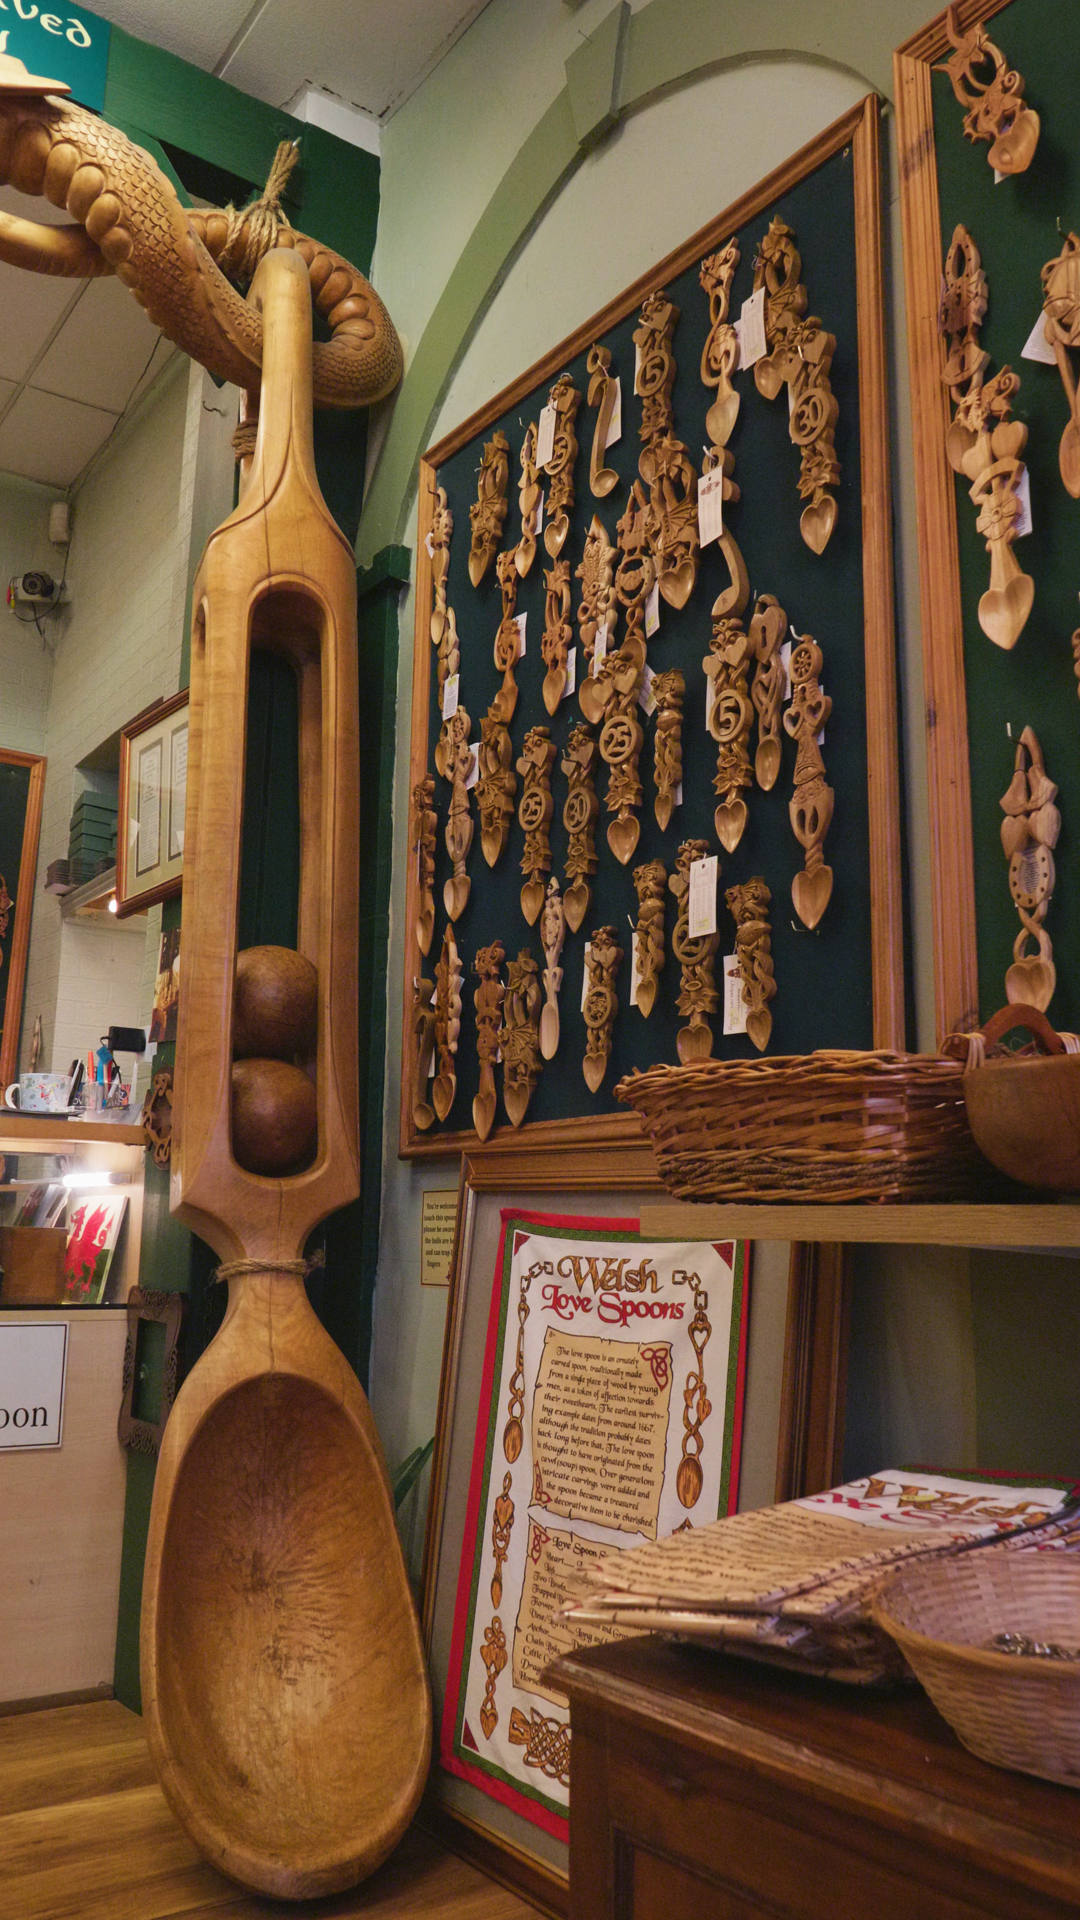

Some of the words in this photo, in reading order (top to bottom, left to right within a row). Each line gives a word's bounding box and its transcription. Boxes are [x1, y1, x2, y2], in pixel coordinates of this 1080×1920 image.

[0, 0, 92, 48] ved
[427, 1260, 440, 1268] fingers
[557, 1255, 664, 1294] Welsh
[541, 1284, 594, 1320] Love
[597, 1292, 686, 1328] Spoons
[551, 1359, 570, 1368] carved
[590, 1365, 624, 1380] traditionally
[625, 1370, 642, 1379] made
[557, 1346, 569, 1356] The
[571, 1348, 582, 1358] love
[584, 1350, 600, 1362] spoon
[616, 1356, 639, 1368] ornately
[546, 1382, 562, 1392] men,
[577, 1387, 592, 1396] token
[601, 1390, 626, 1403] affection
[627, 1395, 654, 1406] towards
[547, 1369, 563, 1380] from
[570, 1374, 585, 1385] single
[587, 1376, 600, 1387] piece
[610, 1381, 627, 1390] wood
[629, 1382, 636, 1394] by
[638, 1385, 658, 1396] young
[542, 1405, 553, 1415] ing
[555, 1409, 580, 1421] example
[582, 1413, 596, 1423] dates
[596, 1416, 612, 1426] from
[614, 1420, 636, 1431] around
[544, 1392, 560, 1402] their
[598, 1403, 613, 1414] The
[615, 1406, 637, 1417] earliest
[638, 1410, 664, 1419] surviv-
[537, 1428, 552, 1439] back
[554, 1432, 569, 1445] long
[571, 1436, 589, 1447] before
[606, 1443, 620, 1454] The
[622, 1446, 635, 1456] love
[637, 1449, 654, 1460] spoon
[539, 1417, 568, 1431] although
[570, 1422, 579, 1432] the
[581, 1424, 606, 1438] tradition
[608, 1432, 633, 1445] probably
[635, 1435, 651, 1445] dates
[542, 1441, 568, 1456] thought
[578, 1449, 592, 1460] have
[594, 1455, 625, 1467] originated
[625, 1459, 640, 1471] from
[642, 1462, 653, 1472] the
[542, 1467, 570, 1480] intricate
[572, 1476, 598, 1490] carvings
[600, 1482, 616, 1492] were
[618, 1485, 636, 1496] added
[637, 1490, 650, 1499] and
[600, 1468, 617, 1478] Over
[618, 1473, 655, 1486] generations
[546, 1481, 555, 1491] the
[558, 1486, 577, 1495] spoon
[579, 1489, 602, 1502] became
[610, 1497, 639, 1510] treasured
[554, 1496, 588, 1512] decorative
[590, 1505, 603, 1517] item
[613, 1510, 620, 1520] be
[622, 1513, 654, 1528] cherished.
[552, 1536, 571, 1550] Love
[573, 1543, 597, 1556] Spoon
[576, 1627, 593, 1643] Long
[521, 1658, 541, 1676] Drag
